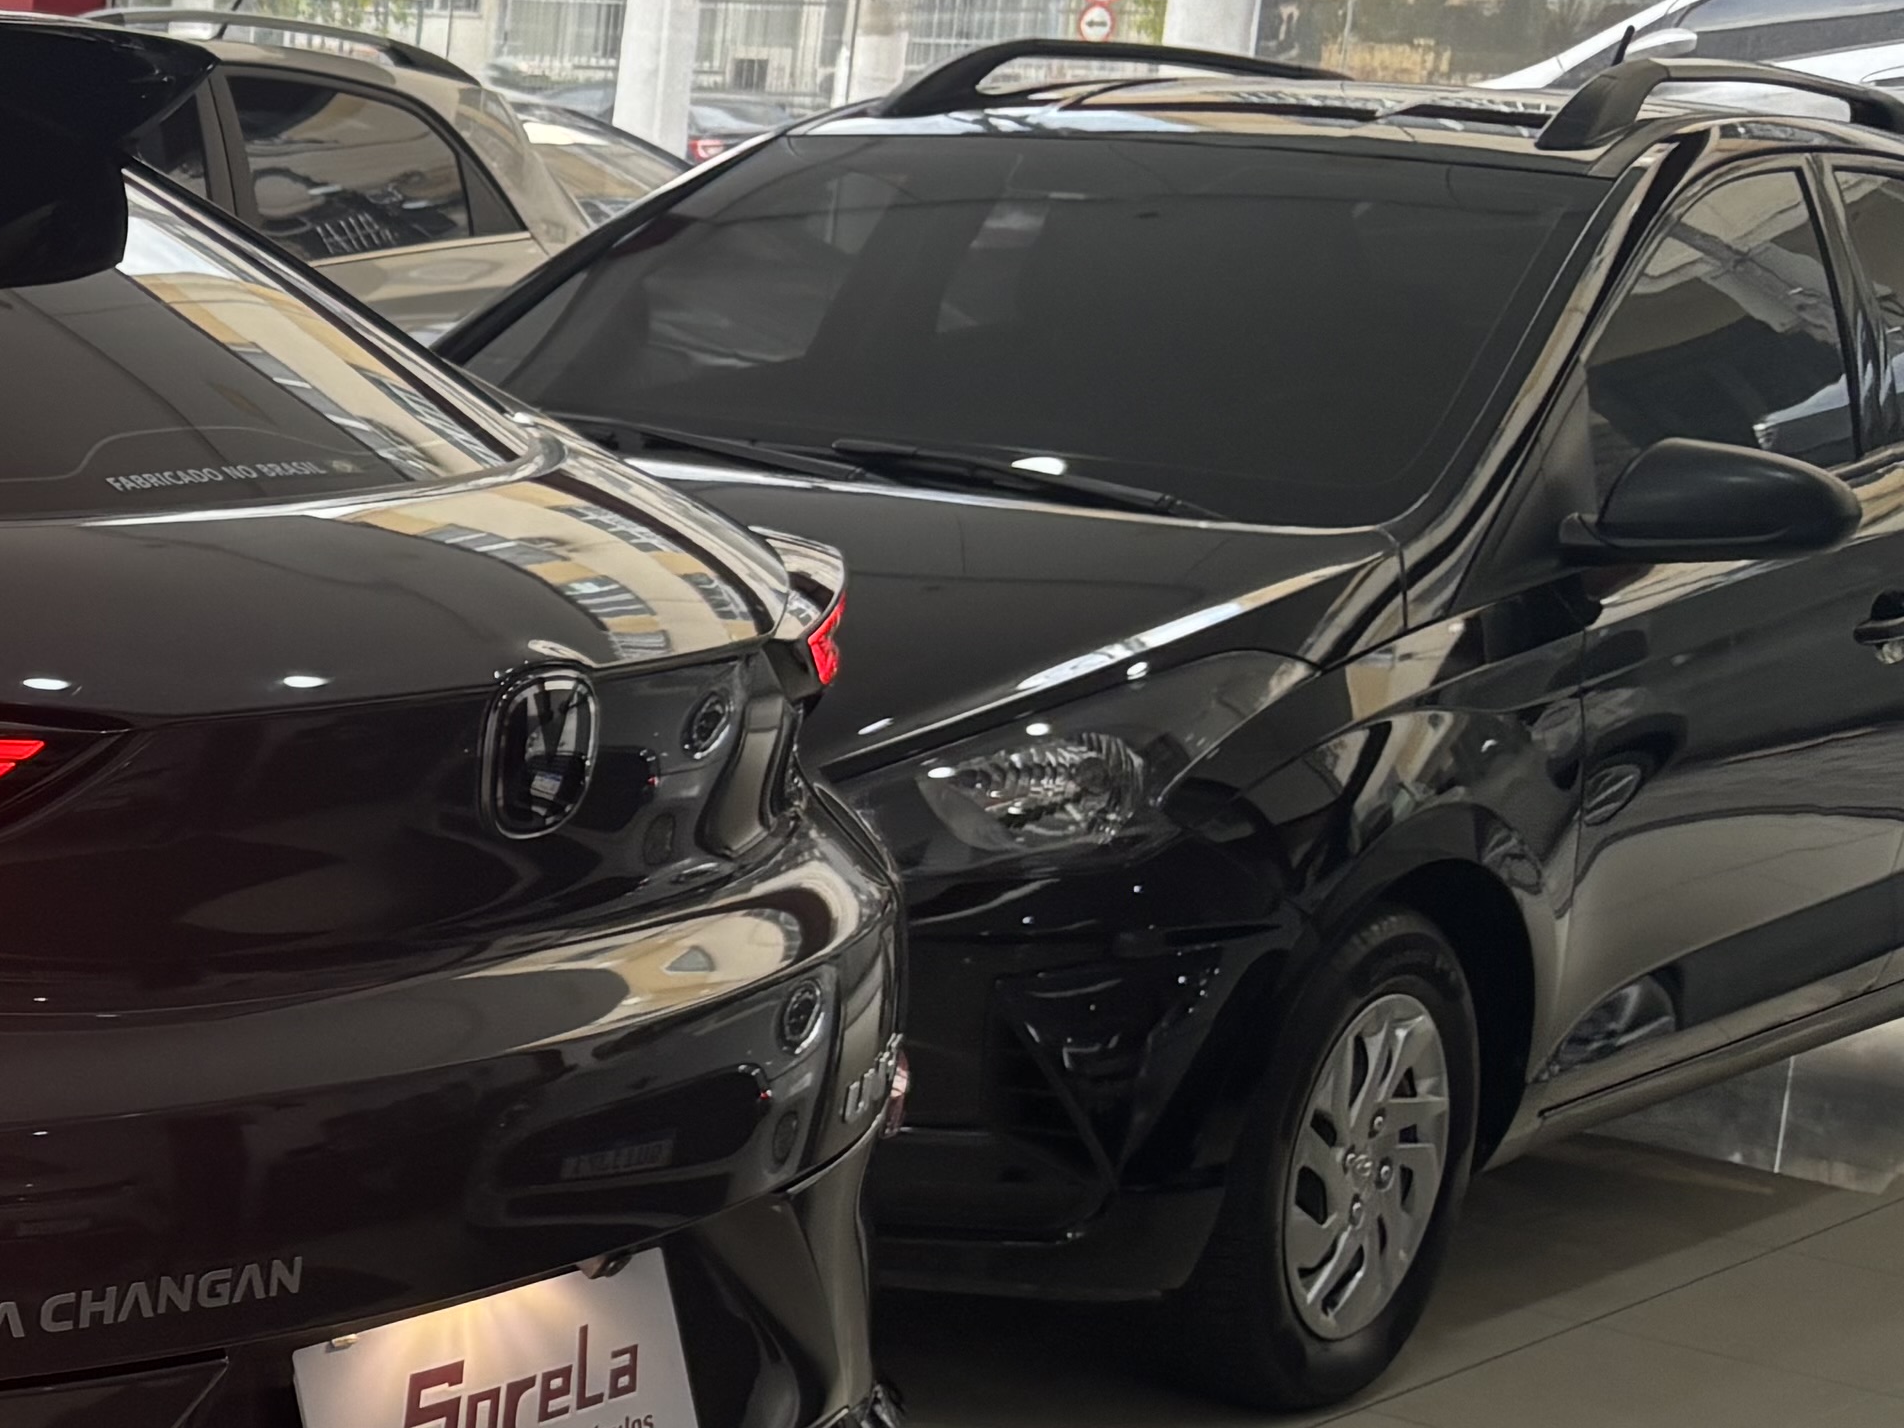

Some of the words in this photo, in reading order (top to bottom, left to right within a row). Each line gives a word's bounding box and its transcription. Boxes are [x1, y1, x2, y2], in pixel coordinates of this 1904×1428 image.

[105, 467, 223, 492] FABRICADO
[222, 465, 258, 479] NO
[256, 460, 327, 477] BRASIL
[40, 1256, 303, 1333] CHANGAN
